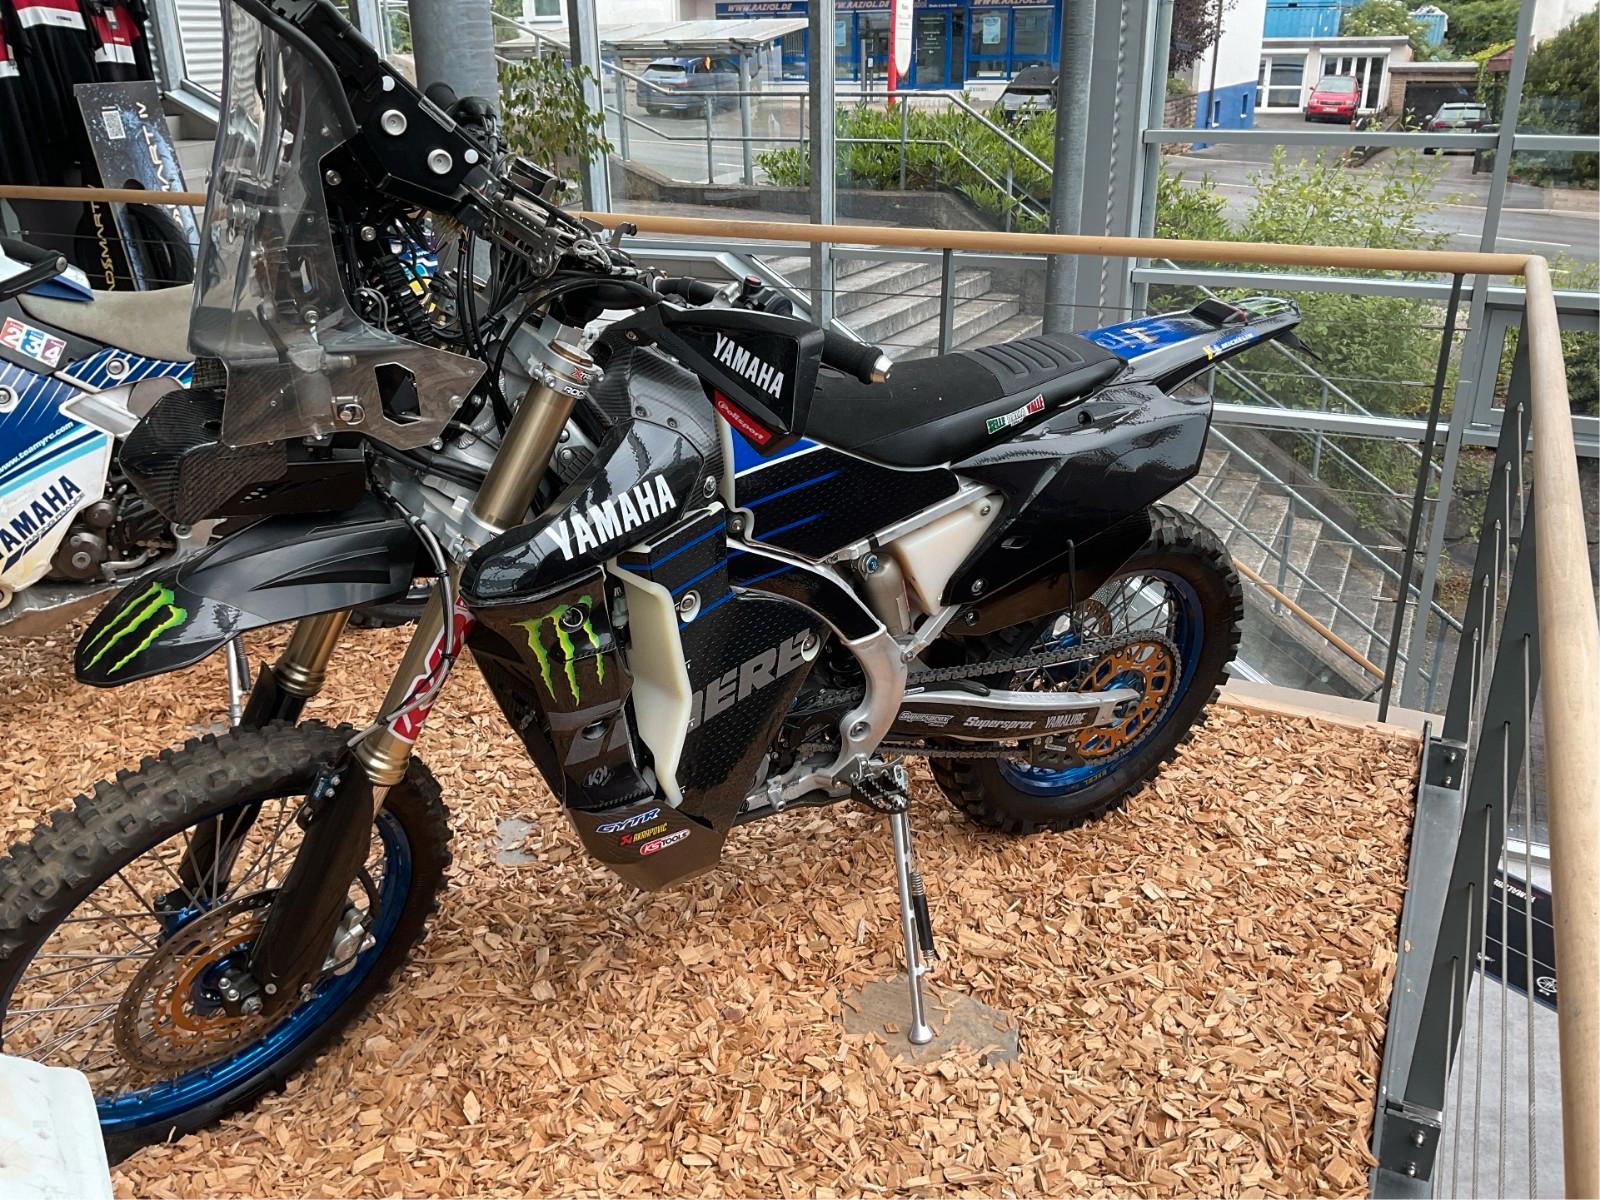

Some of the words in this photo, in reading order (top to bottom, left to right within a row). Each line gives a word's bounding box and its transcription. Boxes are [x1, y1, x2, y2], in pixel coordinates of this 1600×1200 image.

[713, 331, 785, 400] YAMAHA
[0, 475, 82, 559] AMAHA
[543, 474, 677, 561] YAMAHA
[963, 716, 1037, 730] Supersprox
[1045, 712, 1088, 729] YAMALUBE
[595, 807, 661, 834] GYTR
